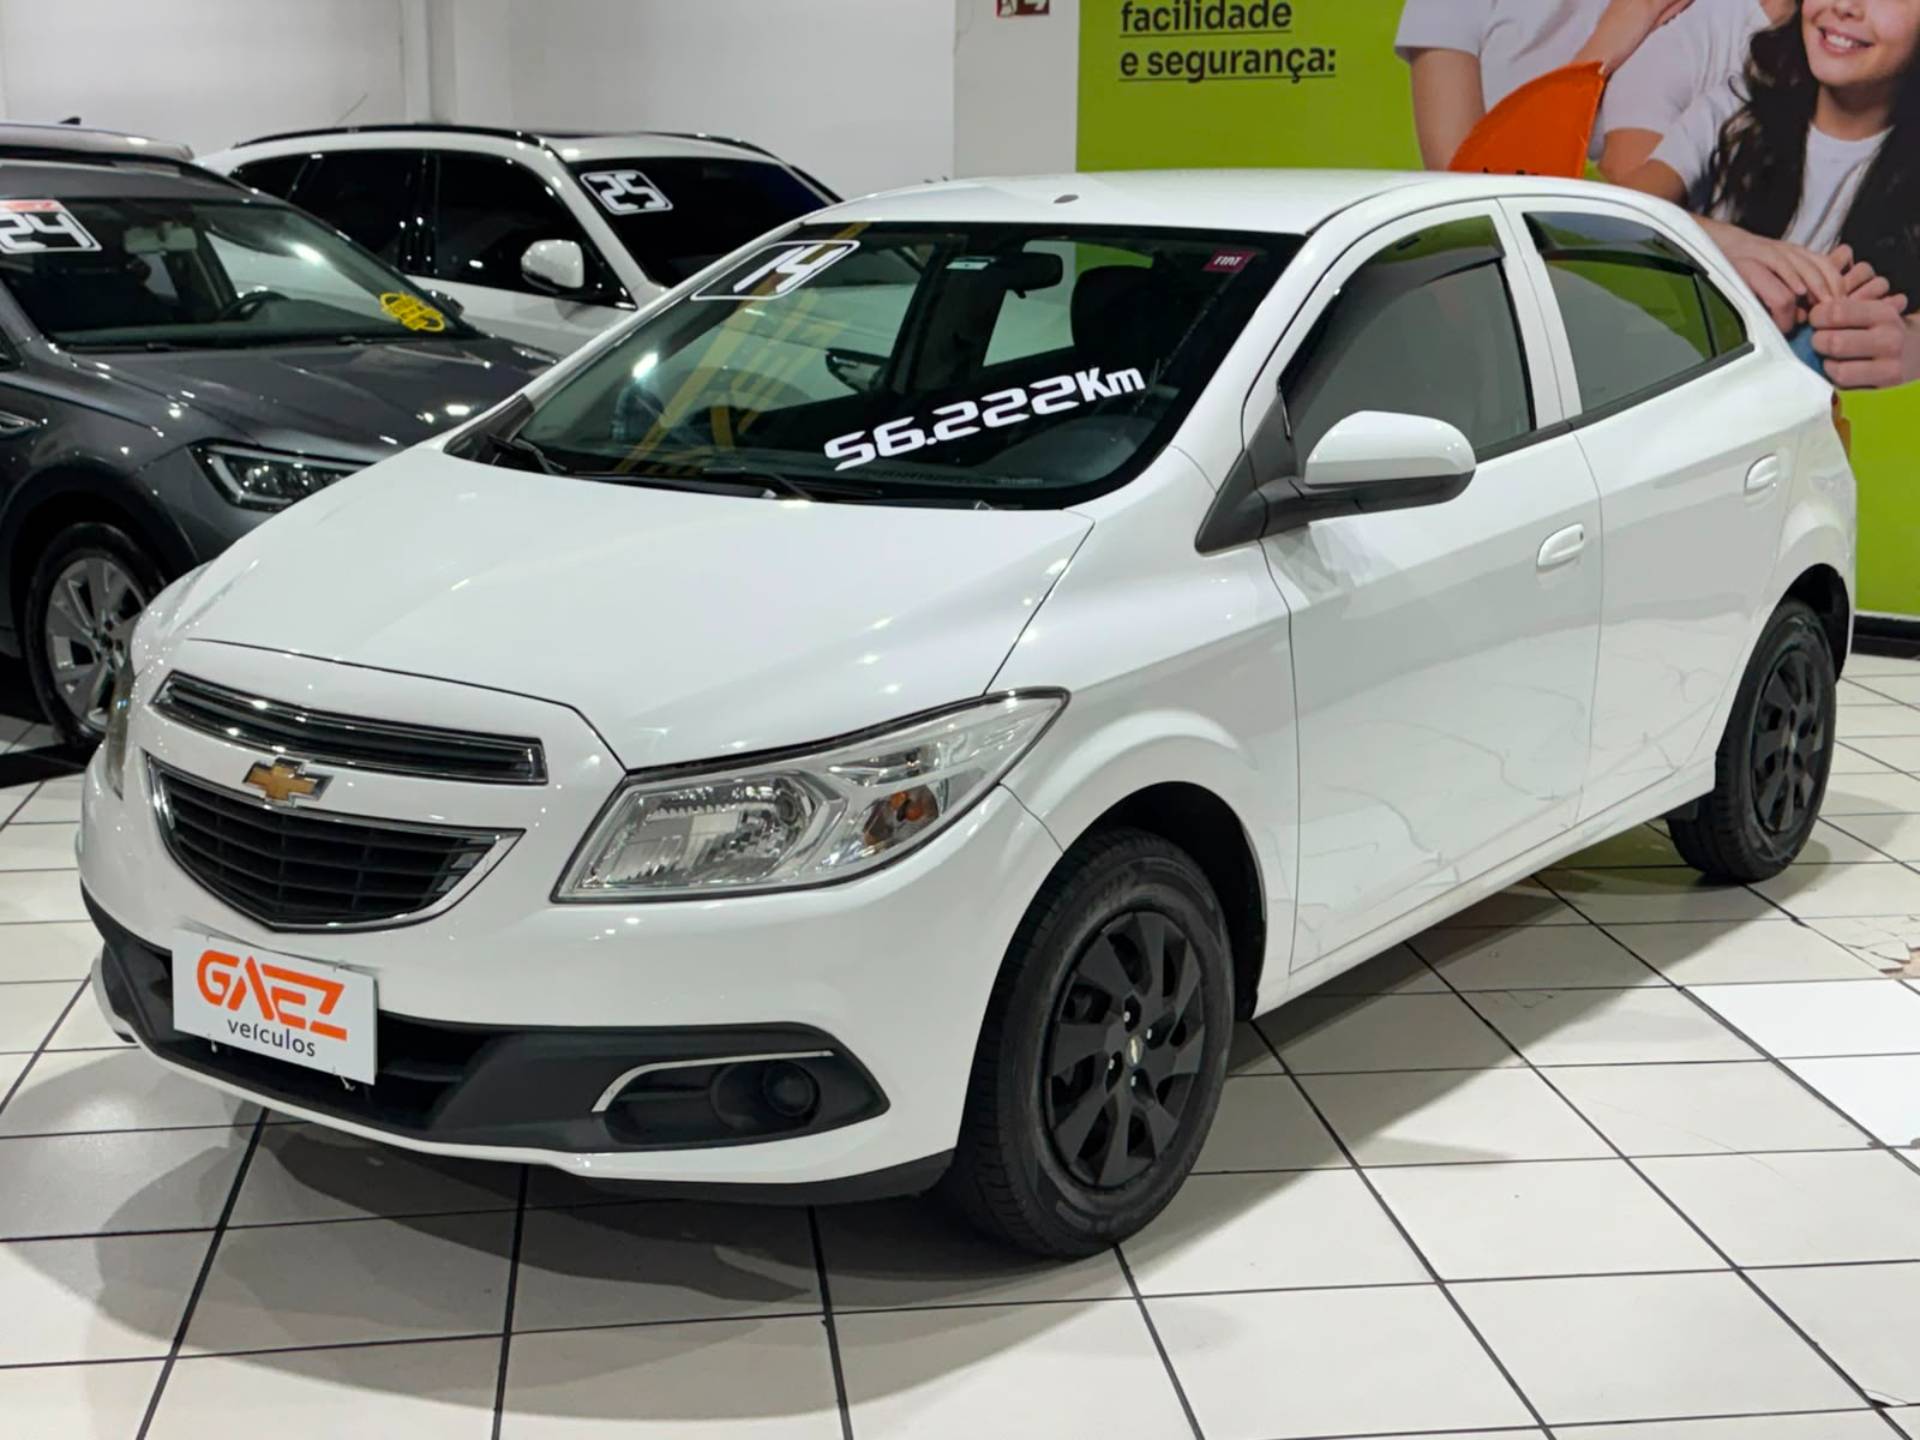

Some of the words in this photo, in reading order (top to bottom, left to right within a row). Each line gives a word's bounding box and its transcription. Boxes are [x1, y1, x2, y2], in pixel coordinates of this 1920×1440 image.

[1121, 0, 1292, 32] facilidade
[1120, 51, 1138, 76] e
[1146, 46, 1337, 83] segurança:
[586, 173, 666, 211] 25
[0, 212, 92, 249] 24
[732, 243, 848, 294] 14
[196, 949, 348, 1042] GAEZ
[226, 1018, 317, 1058] veículos
